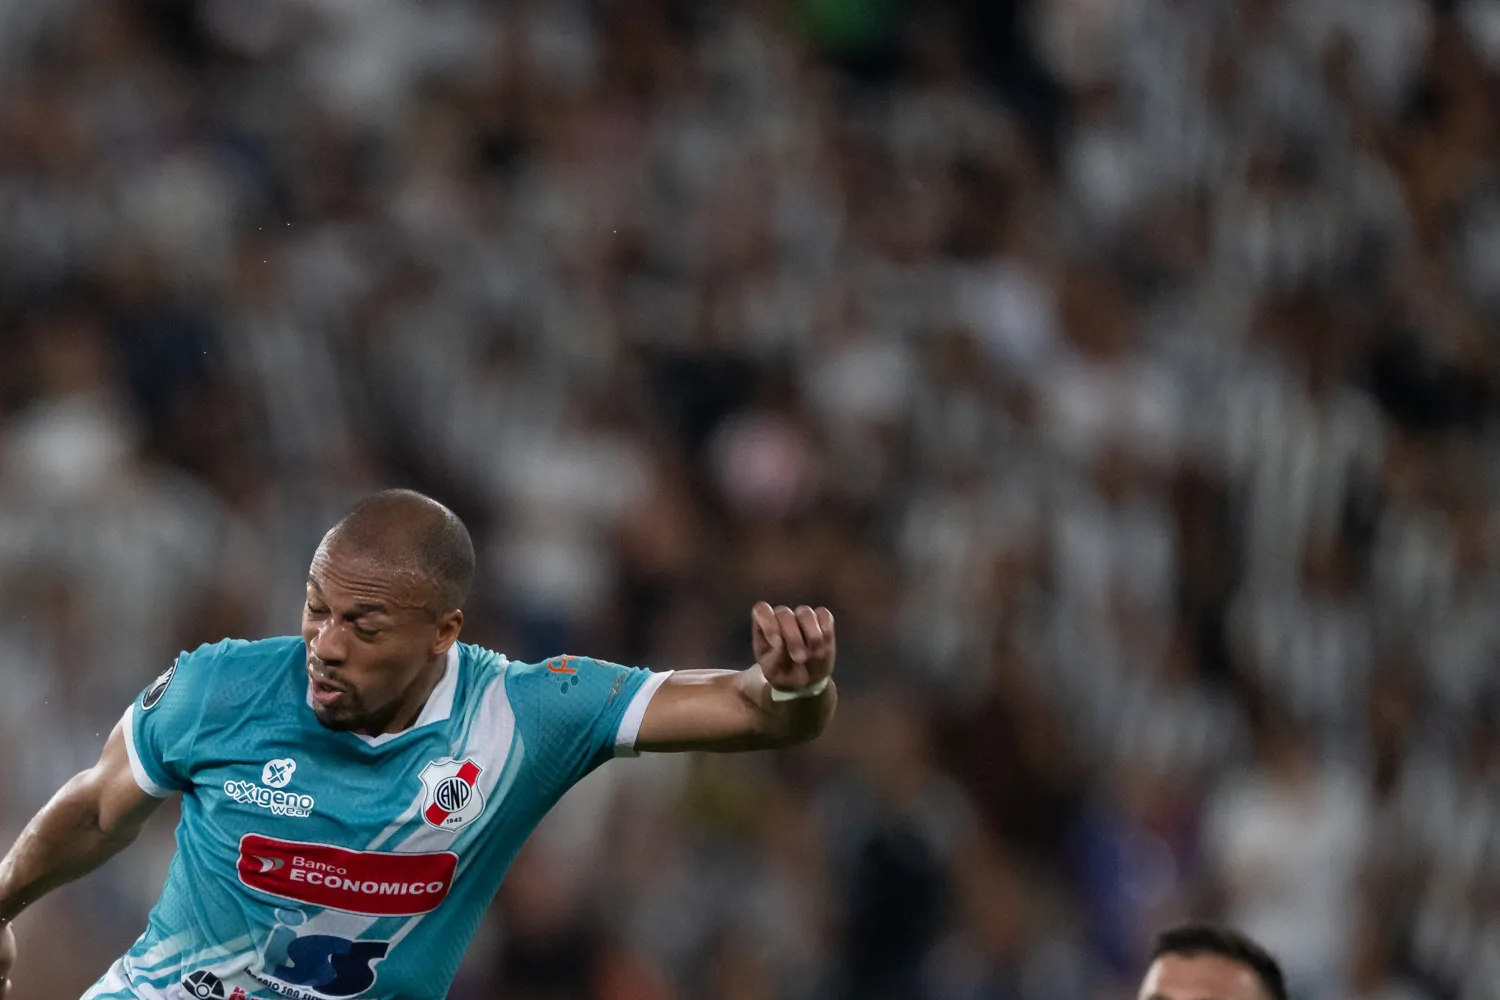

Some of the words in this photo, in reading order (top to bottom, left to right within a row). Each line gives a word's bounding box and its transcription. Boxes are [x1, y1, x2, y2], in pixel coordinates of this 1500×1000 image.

[271, 804, 313, 818] wear
[292, 856, 347, 875] Banco
[289, 868, 444, 896] ECONOMICO
